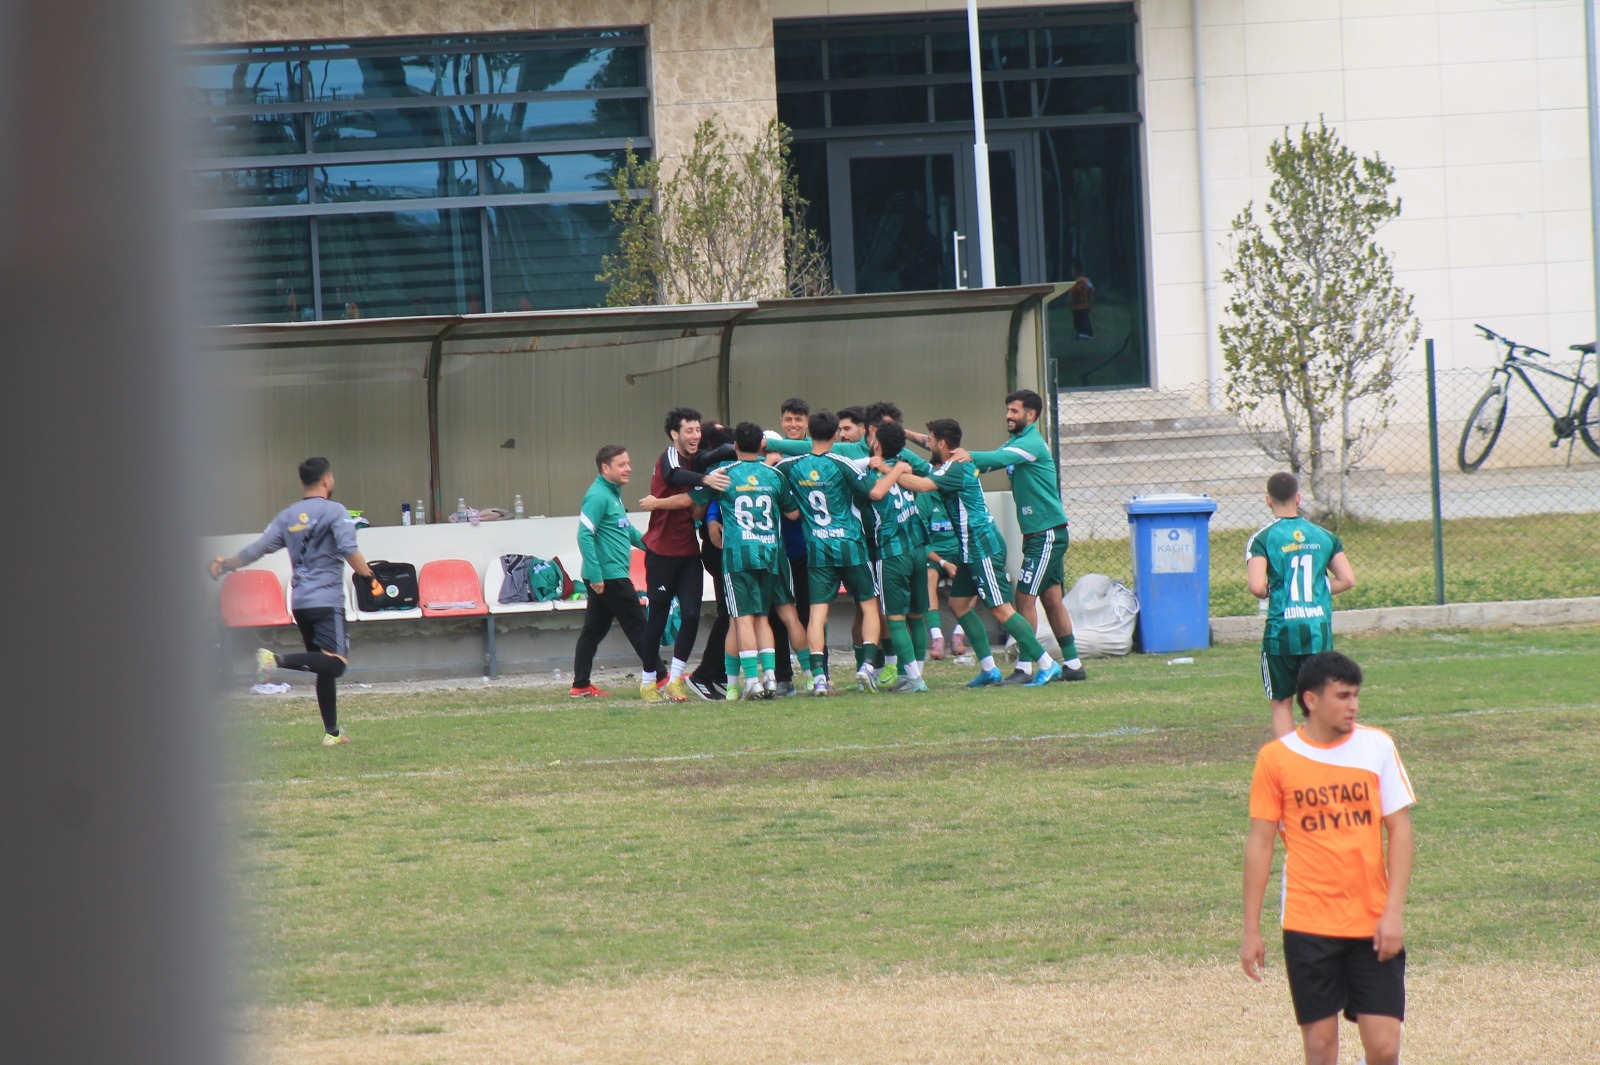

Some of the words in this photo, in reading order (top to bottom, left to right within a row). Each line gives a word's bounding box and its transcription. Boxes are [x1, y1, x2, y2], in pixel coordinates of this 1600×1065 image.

[734, 494, 773, 531] 63
[808, 490, 832, 526] 9
[1021, 506, 1033, 515] 65
[1290, 553, 1313, 603] 11
[1305, 605, 1324, 617] SPOR
[1294, 781, 1370, 808] POSTACI
[1301, 808, 1372, 832] GİYİM
